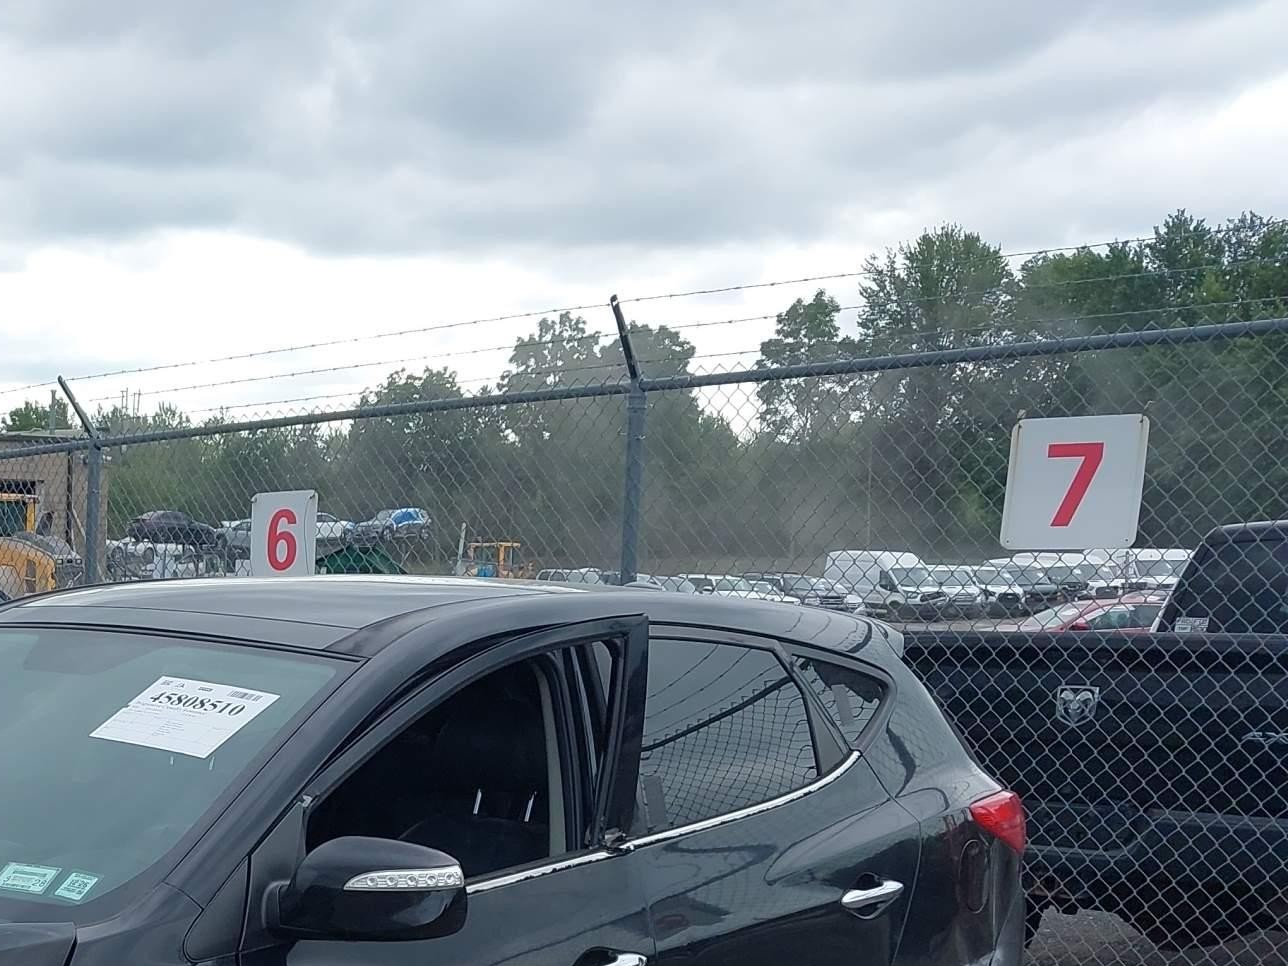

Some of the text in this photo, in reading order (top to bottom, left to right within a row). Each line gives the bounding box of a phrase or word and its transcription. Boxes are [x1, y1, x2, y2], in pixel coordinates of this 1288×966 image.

[1048, 442, 1104, 527] 7
[267, 508, 298, 571] 6
[150, 691, 246, 716] 45808510
